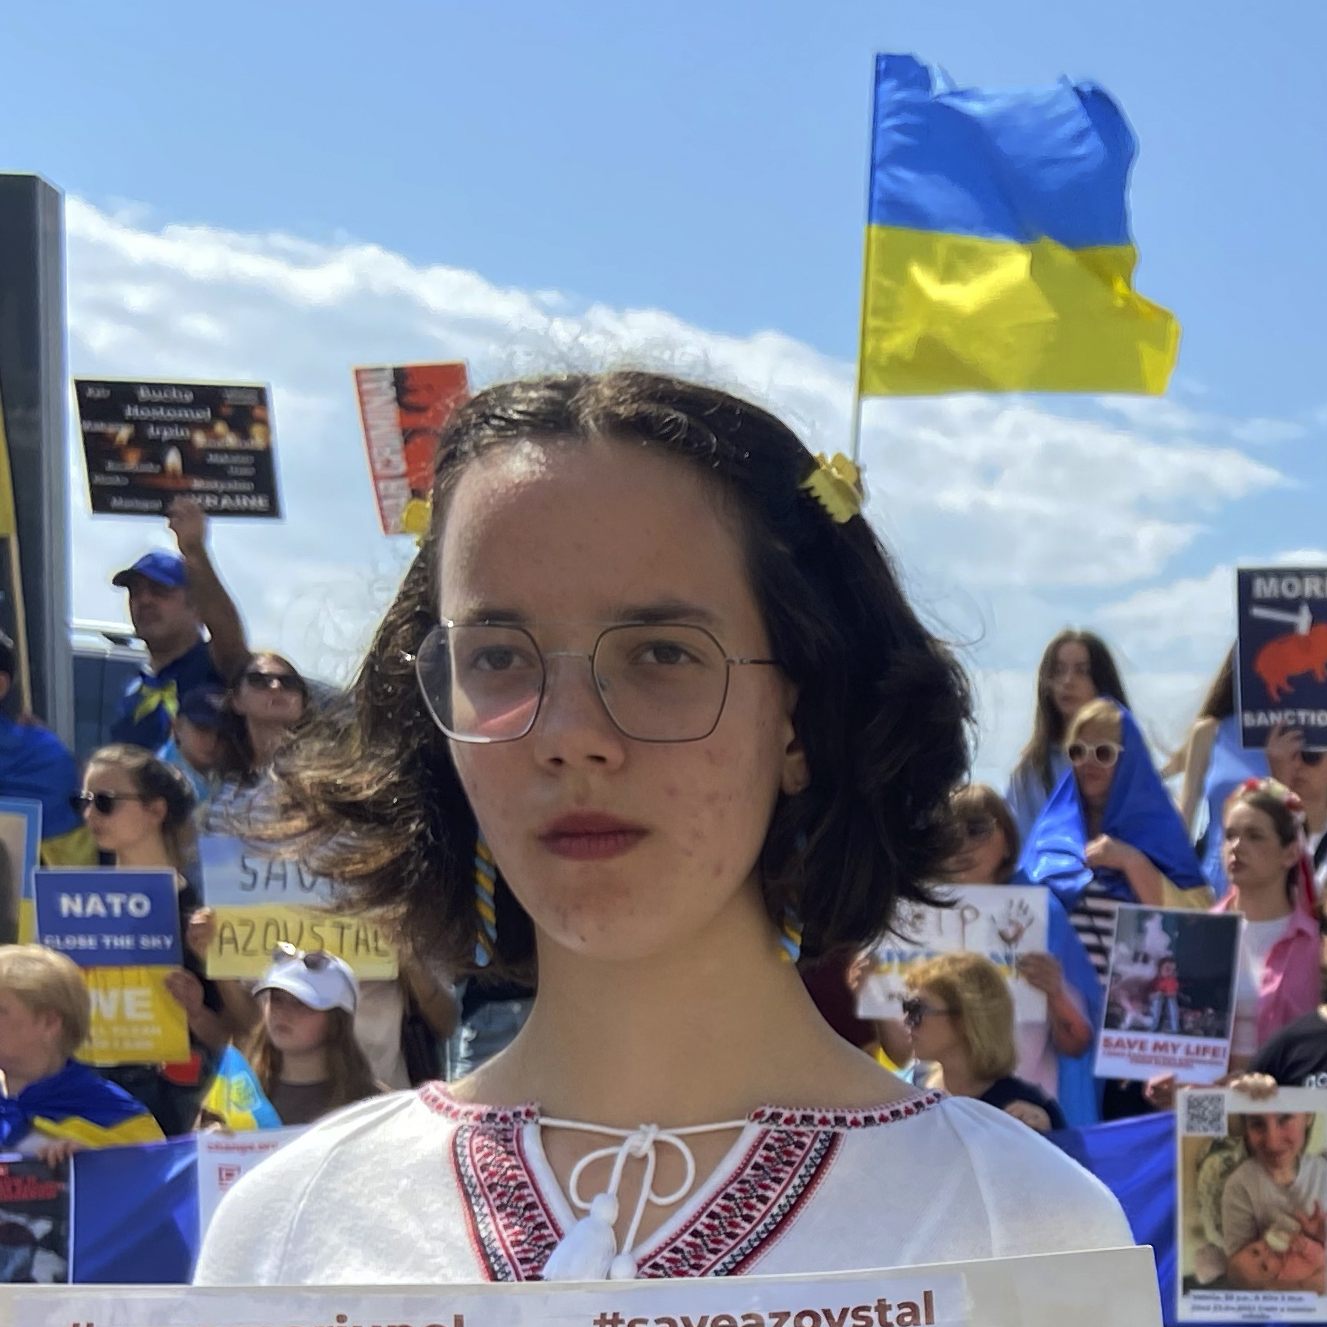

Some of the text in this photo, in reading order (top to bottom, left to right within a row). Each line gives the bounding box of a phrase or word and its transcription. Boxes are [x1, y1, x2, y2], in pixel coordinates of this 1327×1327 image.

[238, 854, 341, 893] SAV
[59, 892, 152, 918] NATO
[101, 934, 136, 950] THE
[139, 934, 174, 950] SKY
[1102, 1036, 1149, 1051] SAVE
[1152, 1040, 1181, 1054] MY
